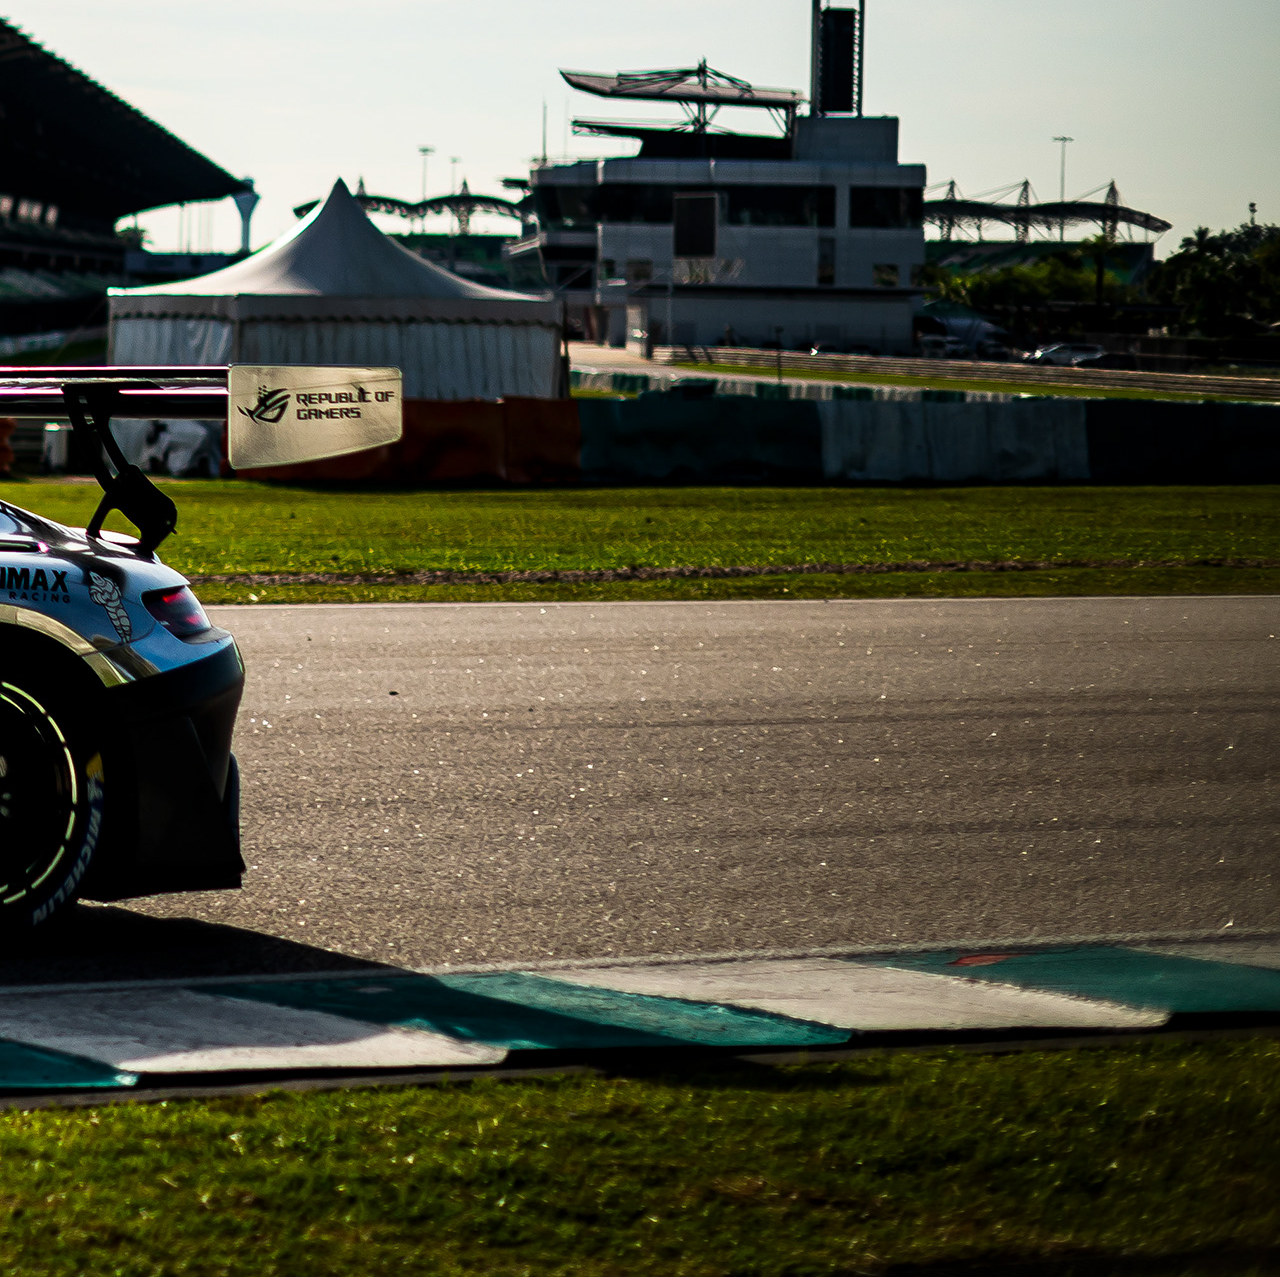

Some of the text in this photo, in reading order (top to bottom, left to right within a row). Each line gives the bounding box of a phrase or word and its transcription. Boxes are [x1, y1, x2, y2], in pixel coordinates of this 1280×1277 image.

[295, 390, 395, 407] REPUBLIC OF
[296, 407, 361, 421] GAMERS
[8, 591, 71, 604] RACING
[32, 806, 102, 927] MICHELIN
